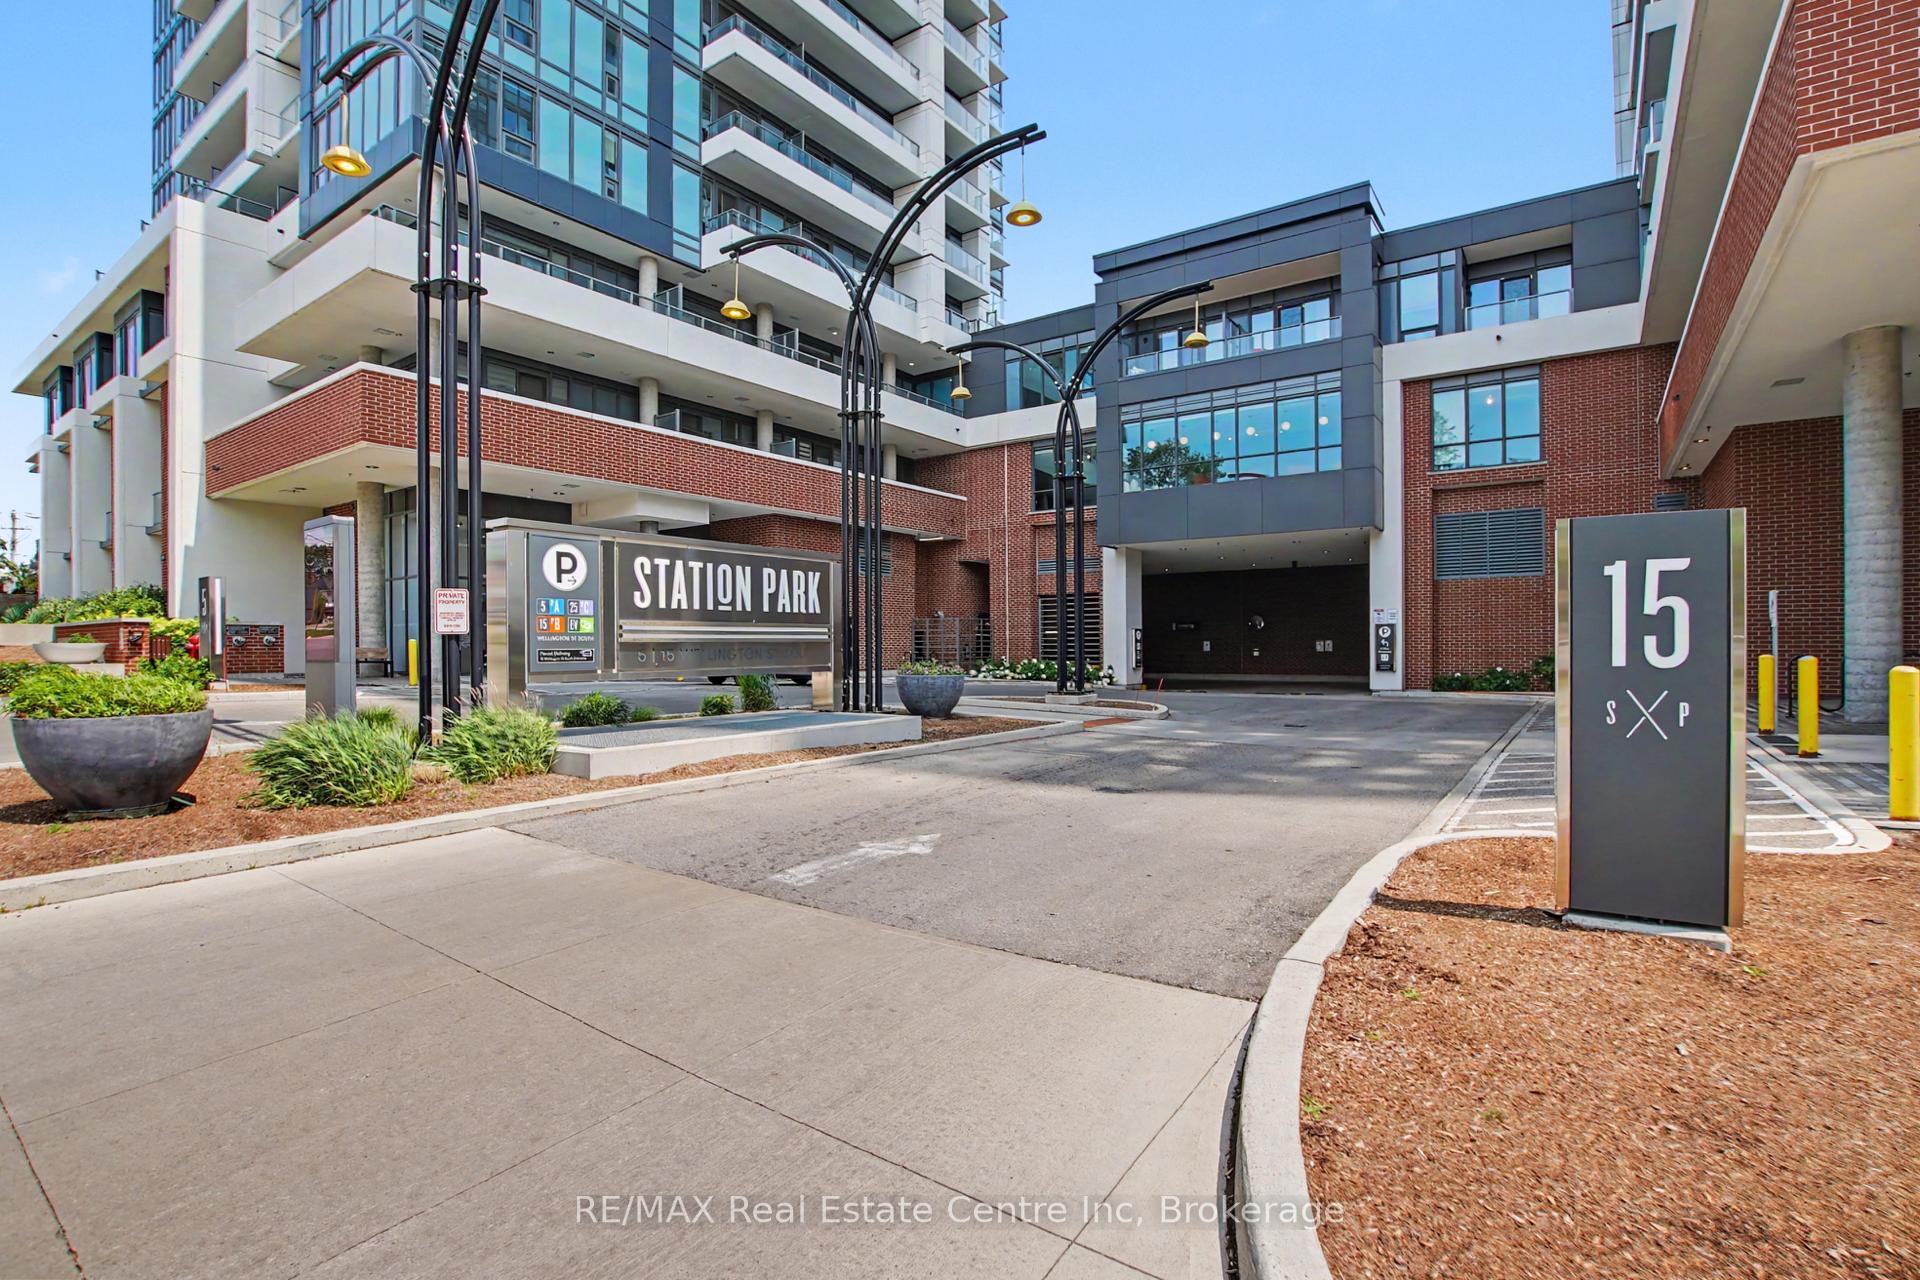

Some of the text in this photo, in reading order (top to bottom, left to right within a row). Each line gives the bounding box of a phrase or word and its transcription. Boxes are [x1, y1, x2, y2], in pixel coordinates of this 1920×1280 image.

[556, 551, 577, 583] P
[633, 556, 821, 614] STATION PARK
[201, 588, 207, 616] 5
[569, 602, 578, 613] 25
[1603, 557, 1691, 669] 15
[539, 618, 548, 630] 15
